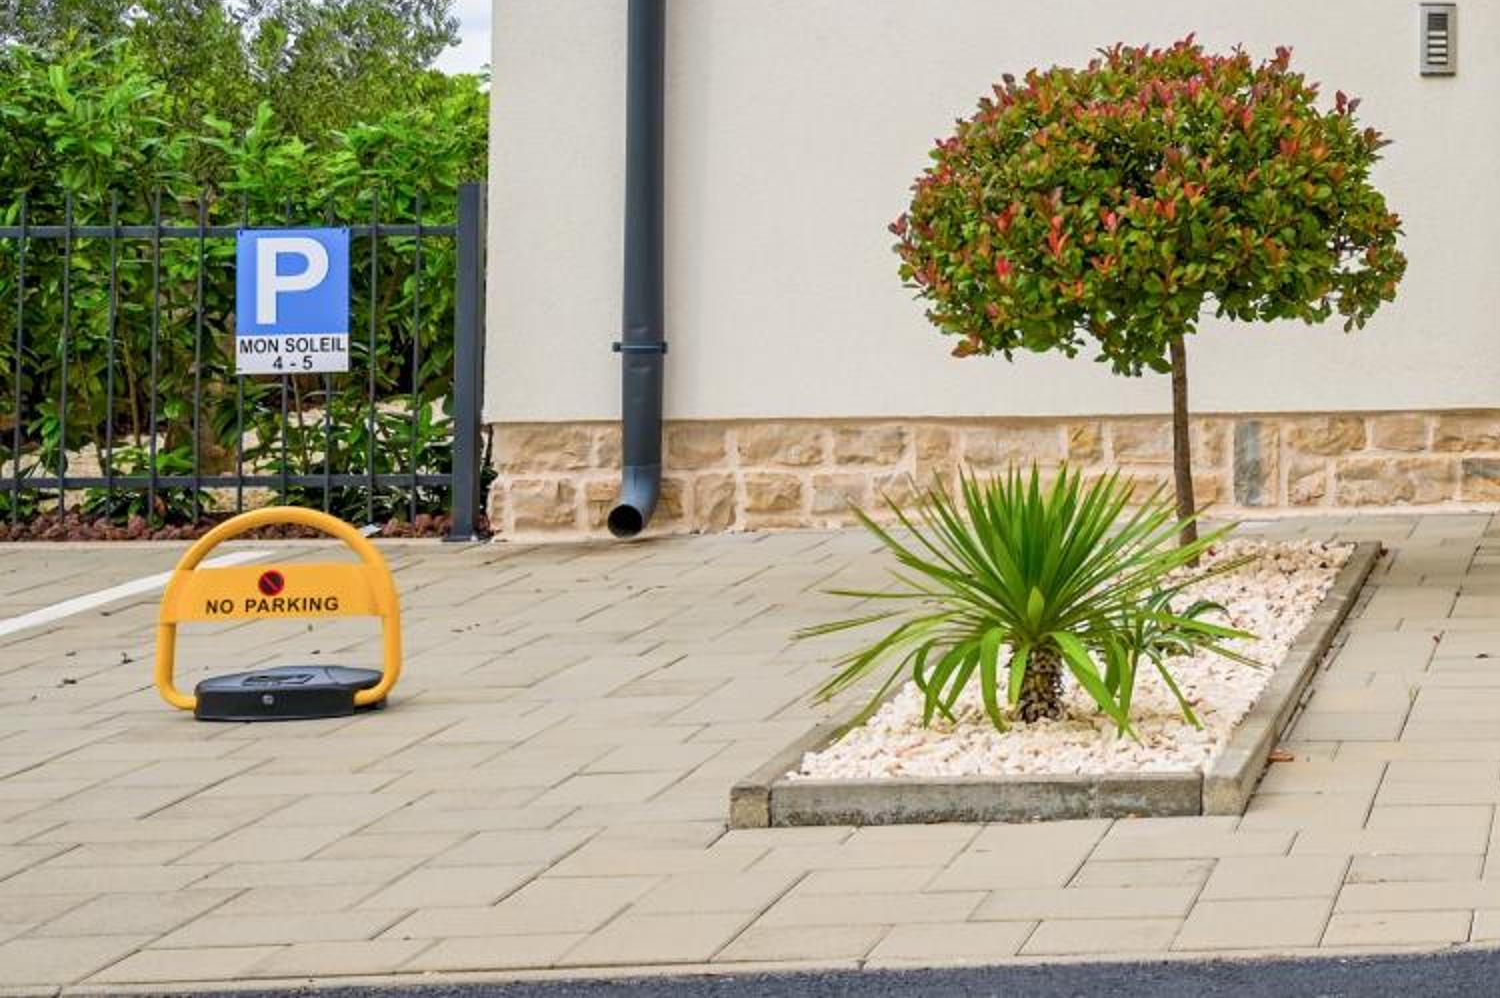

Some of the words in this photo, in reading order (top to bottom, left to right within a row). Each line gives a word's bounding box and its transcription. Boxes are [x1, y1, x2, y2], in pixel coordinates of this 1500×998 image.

[256, 237, 329, 325] P
[240, 337, 279, 354] MON
[285, 335, 346, 353] SOLEIL
[271, 355, 283, 370] 4
[302, 355, 314, 370] 5
[205, 598, 234, 615] NO
[244, 595, 339, 613] PARKING
